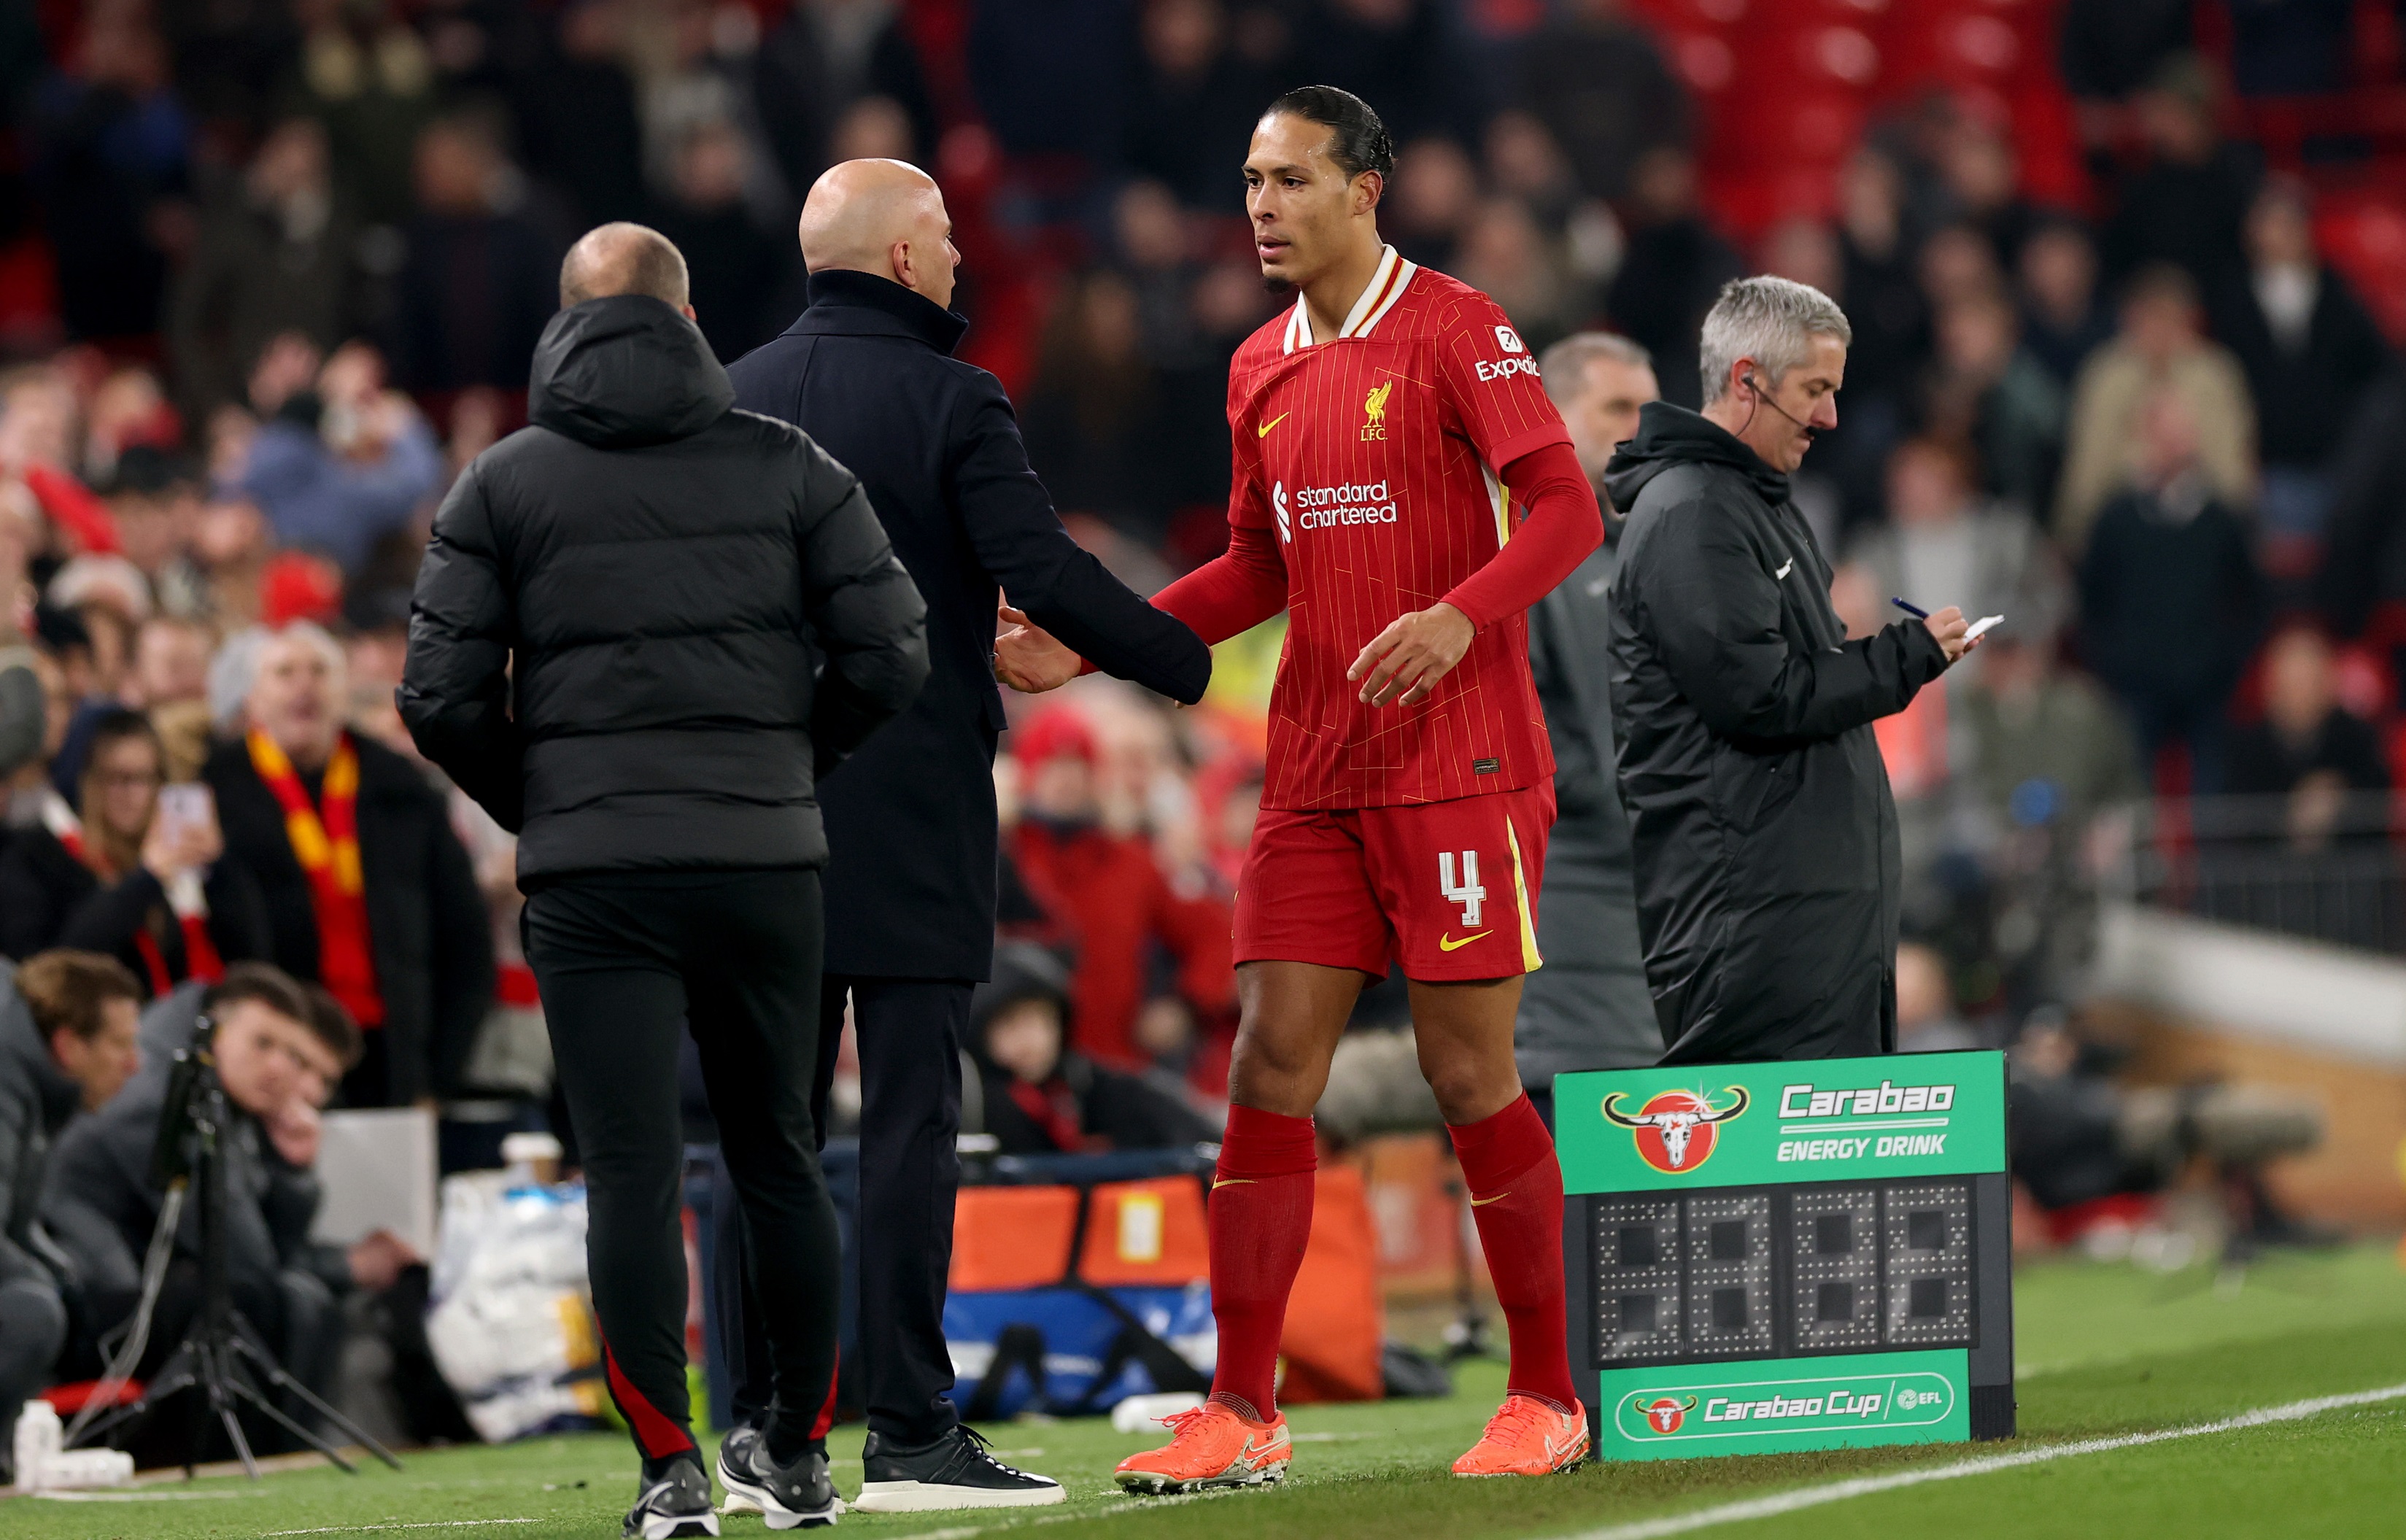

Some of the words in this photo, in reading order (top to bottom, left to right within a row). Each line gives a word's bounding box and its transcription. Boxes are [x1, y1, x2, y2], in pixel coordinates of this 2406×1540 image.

[1296, 479, 1388, 508] standard
[1300, 500, 1397, 530] chartered
[1439, 850, 1487, 927] 4
[1778, 1080, 1956, 1119] Carabao
[1776, 1137, 1871, 1161] ENERGY
[1875, 1134, 1947, 1157] DRINK
[1703, 1394, 1824, 1422] Carabao
[1825, 1390, 1882, 1418] Cup
[1919, 1392, 1942, 1405] EFL
